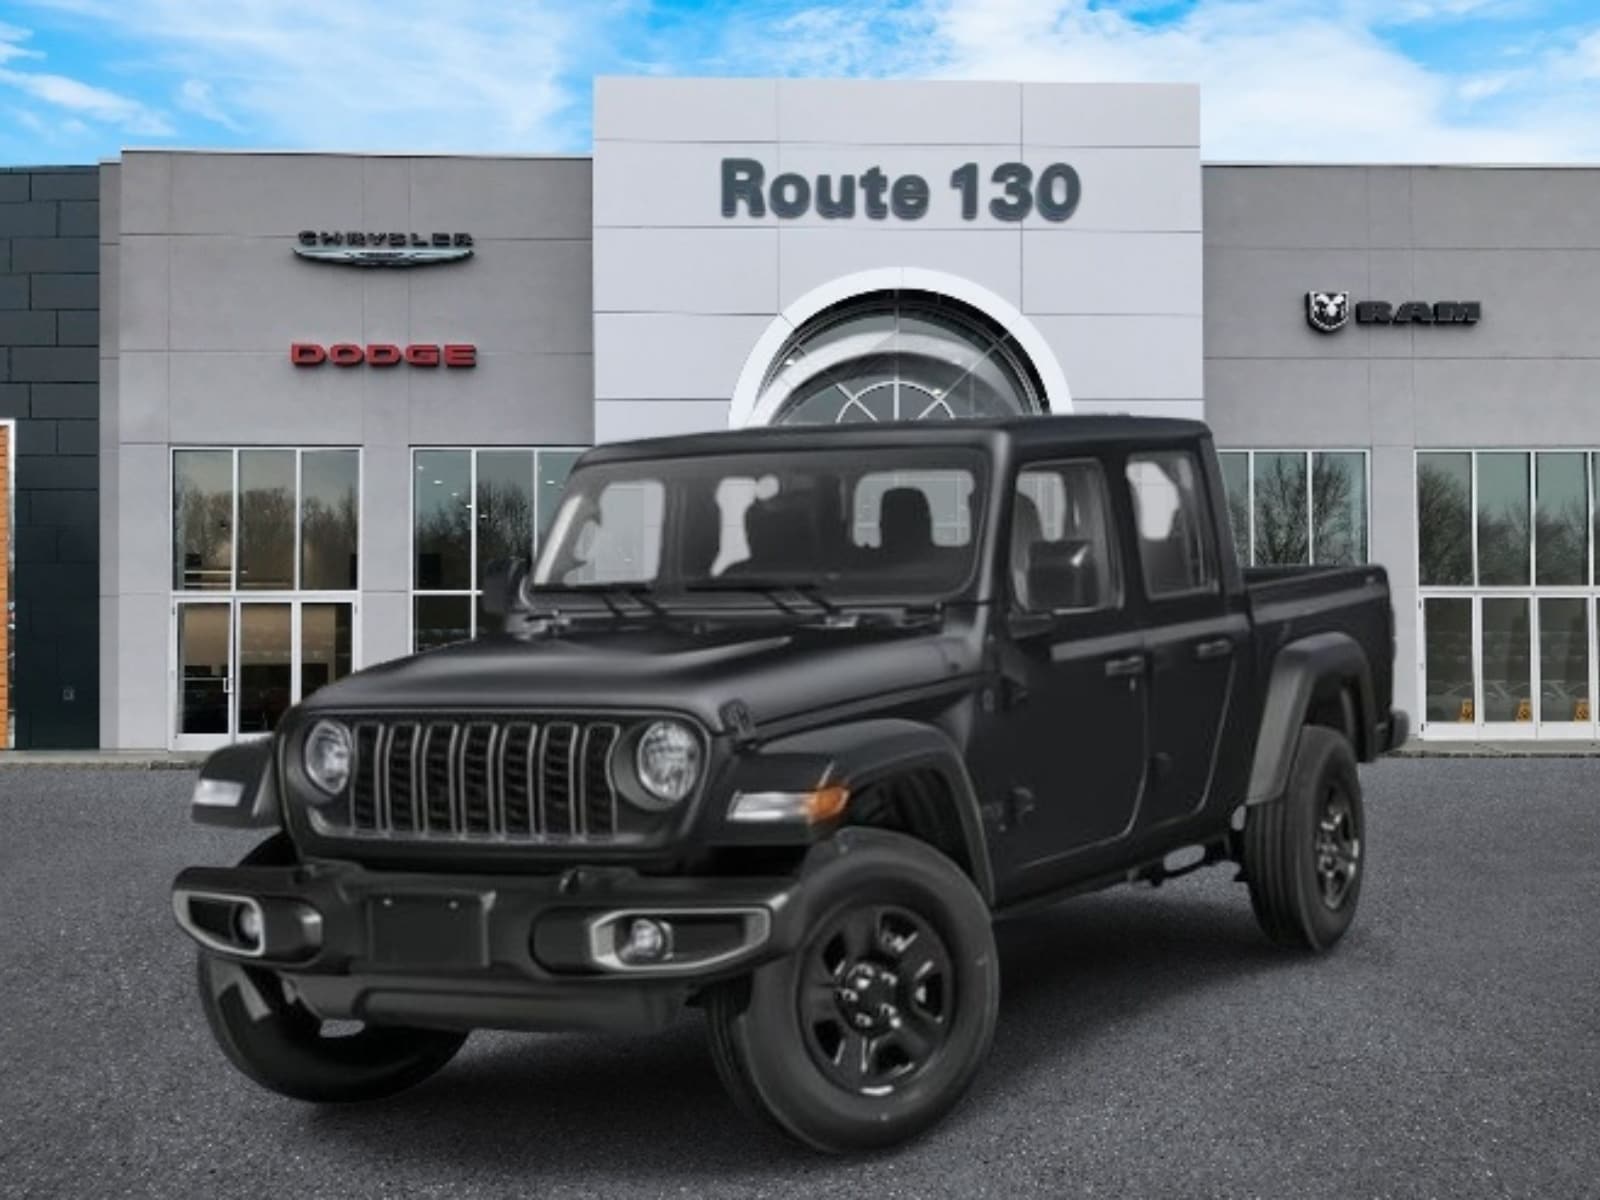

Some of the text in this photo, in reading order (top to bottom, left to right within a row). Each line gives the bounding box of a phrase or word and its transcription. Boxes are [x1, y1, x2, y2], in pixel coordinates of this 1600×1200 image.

[720, 157, 1082, 223] Route 130
[298, 230, 474, 247] CHRYSLER
[1355, 300, 1481, 327] RAM
[291, 343, 477, 369] DODGE
